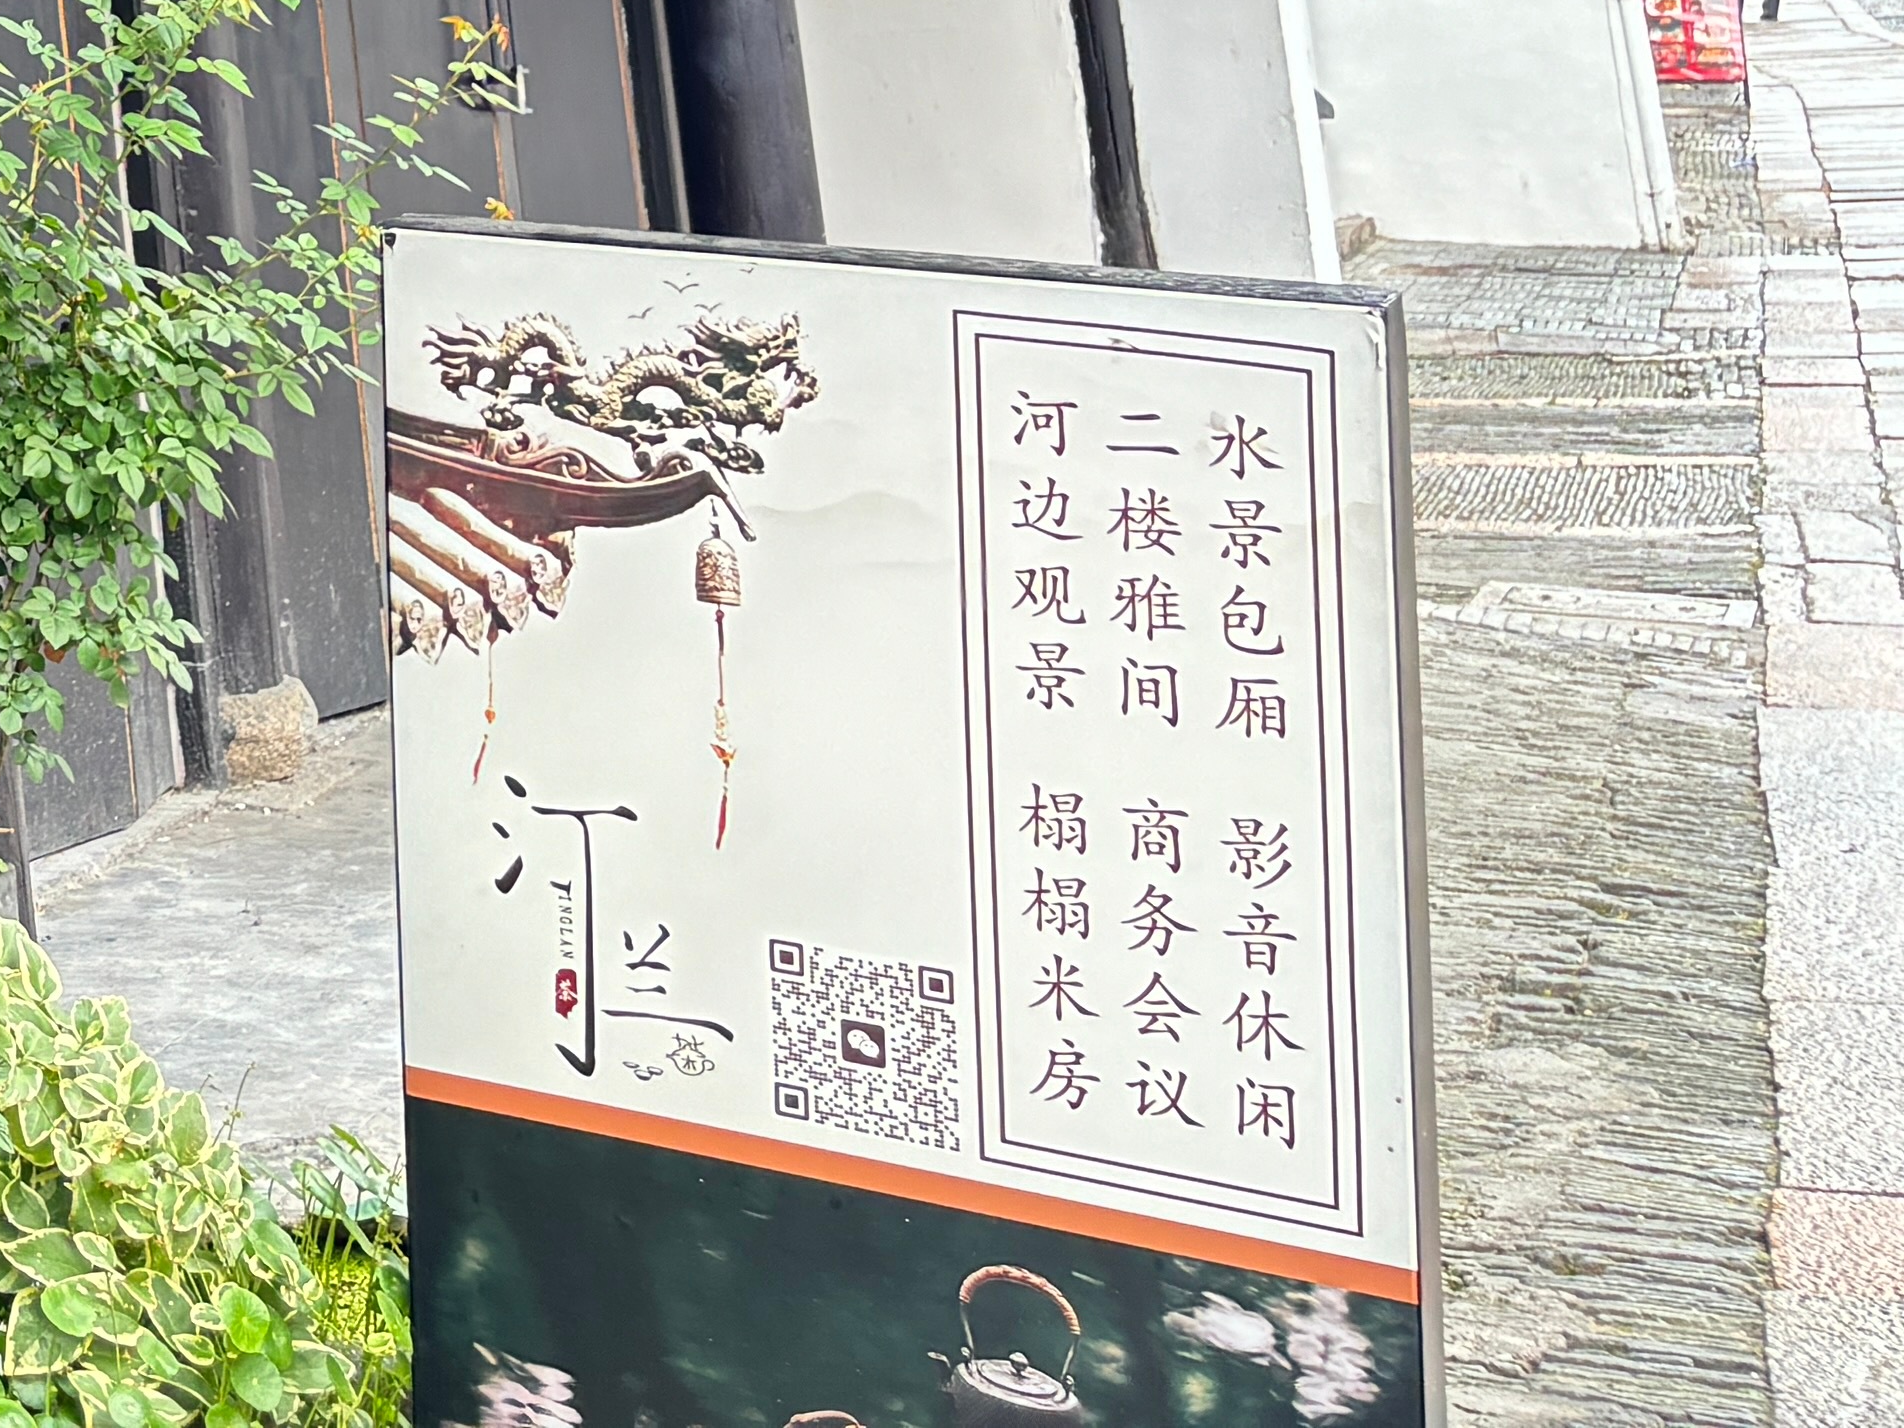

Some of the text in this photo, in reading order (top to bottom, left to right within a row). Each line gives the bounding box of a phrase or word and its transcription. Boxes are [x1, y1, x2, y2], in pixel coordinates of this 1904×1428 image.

[492, 774, 735, 1077] 汀兰
[550, 879, 574, 961] TINGLAN
[1010, 389, 1101, 1111] 河边观景 榻榻米房
[1105, 412, 1204, 1130] 二楼雅间 商务会议
[1209, 413, 1305, 1151] 水景包厢 影音休闲
